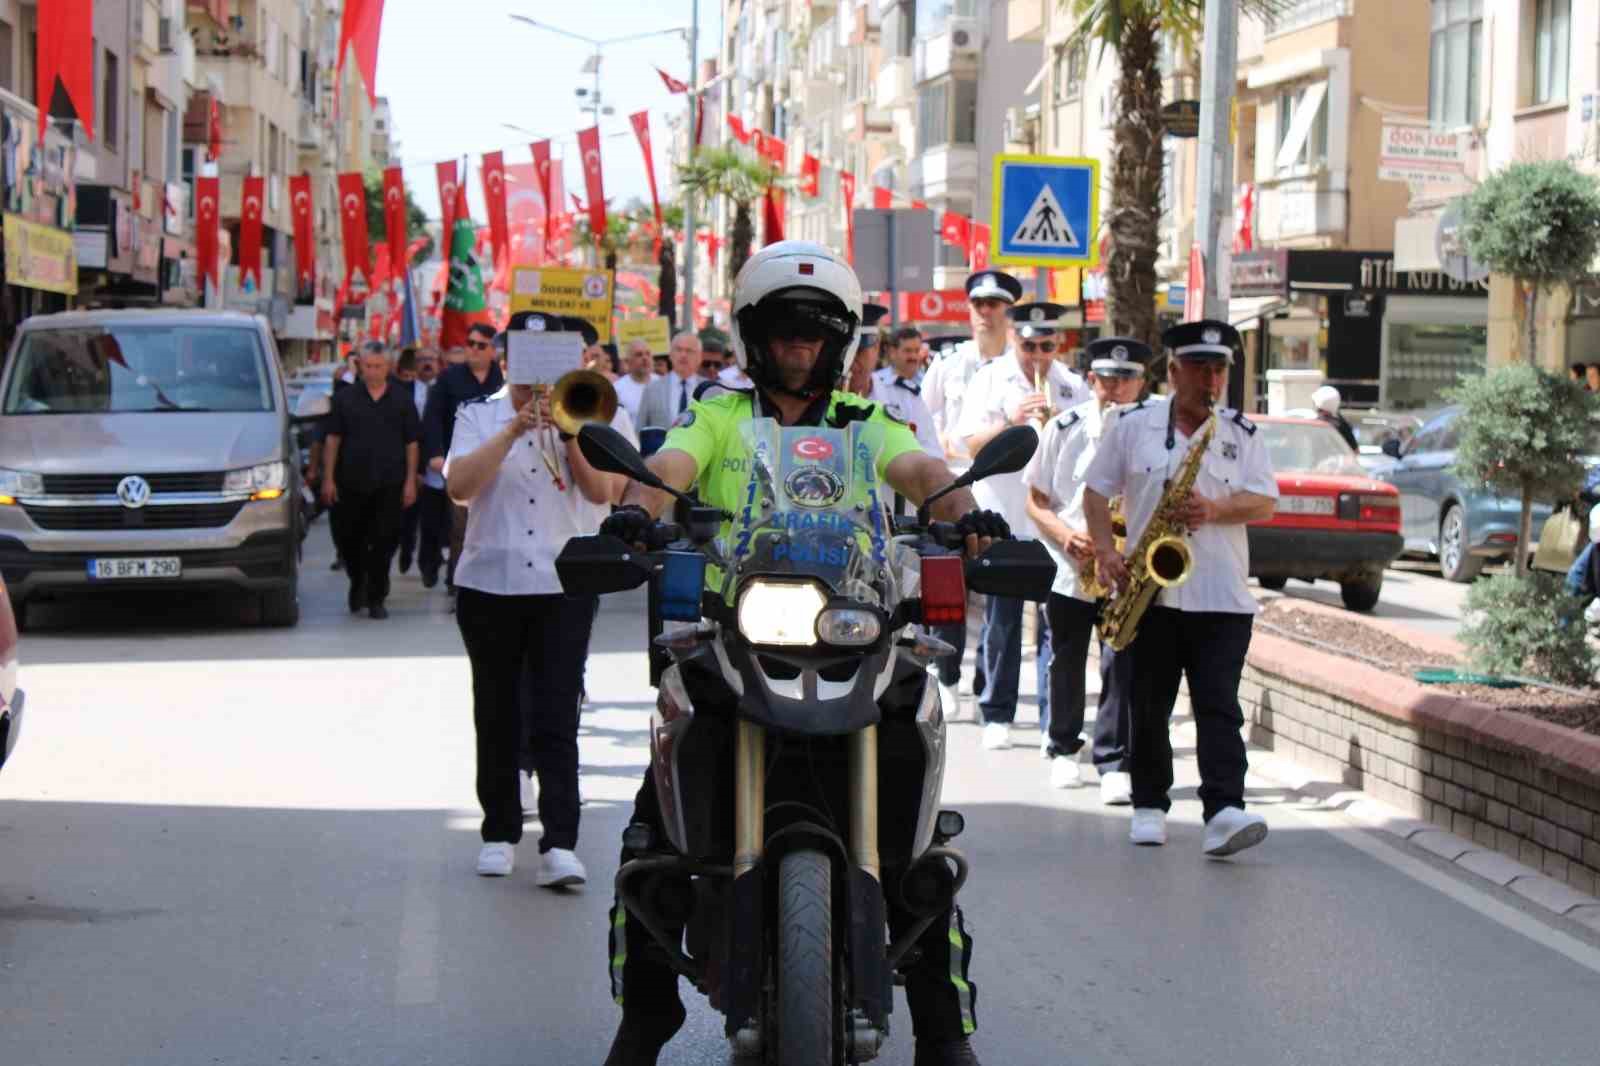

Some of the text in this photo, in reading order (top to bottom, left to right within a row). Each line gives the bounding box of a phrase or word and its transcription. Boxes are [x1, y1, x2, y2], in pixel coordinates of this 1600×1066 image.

[98, 560, 177, 576] 16 BFM 290
